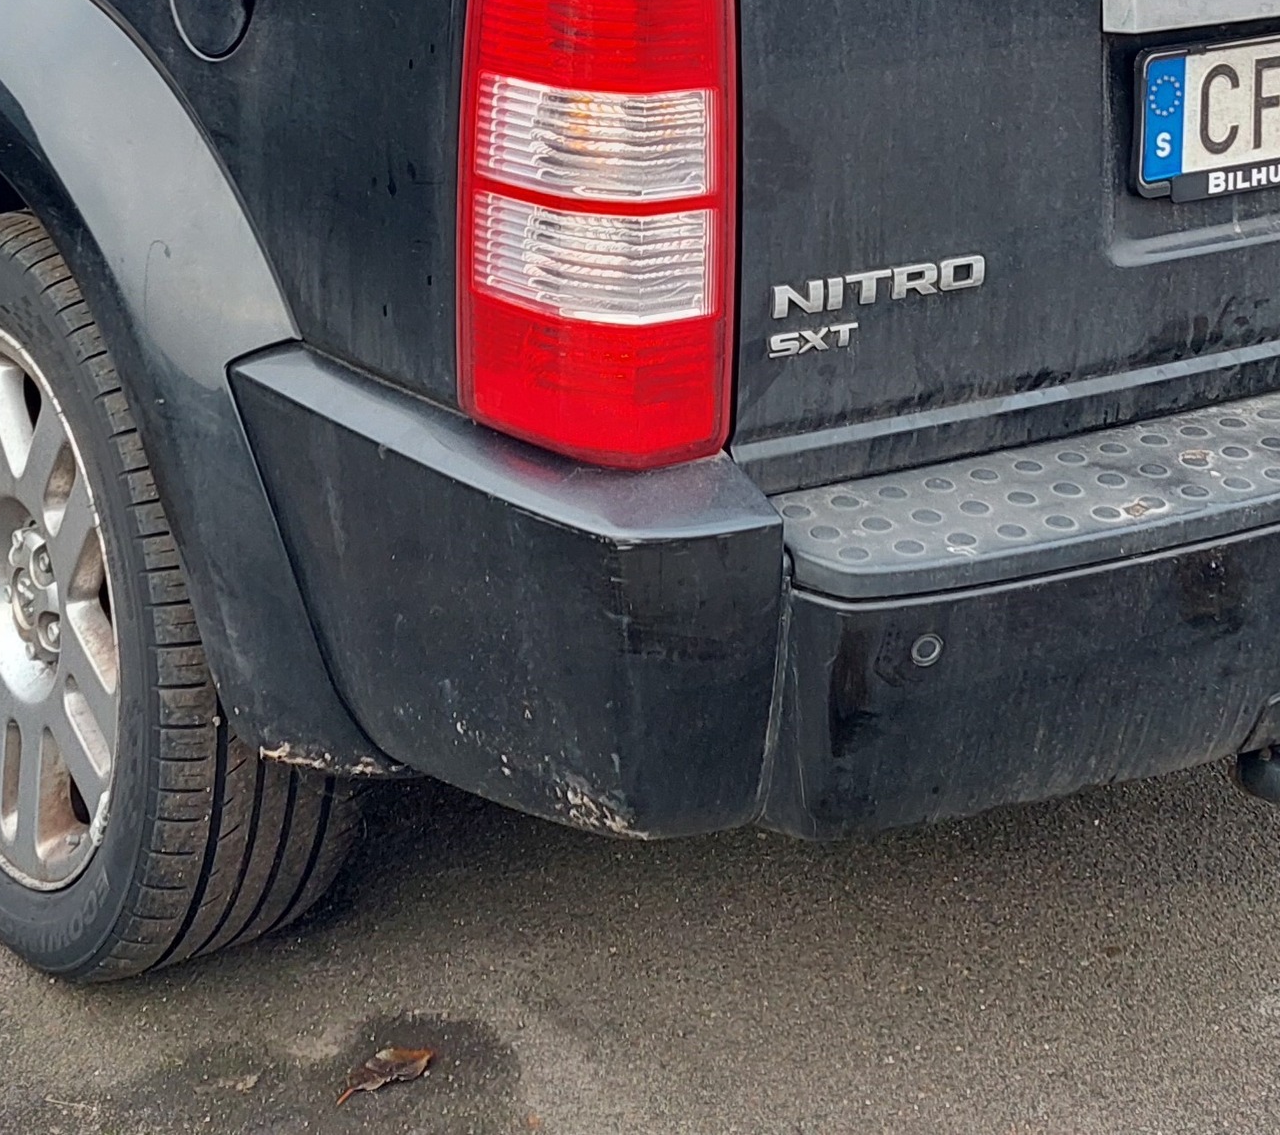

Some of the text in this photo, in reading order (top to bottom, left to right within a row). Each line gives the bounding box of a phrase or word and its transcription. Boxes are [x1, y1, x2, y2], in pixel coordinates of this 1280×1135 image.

[1156, 131, 1172, 158] S
[772, 254, 986, 319] NITRO
[769, 322, 859, 358] SXT
